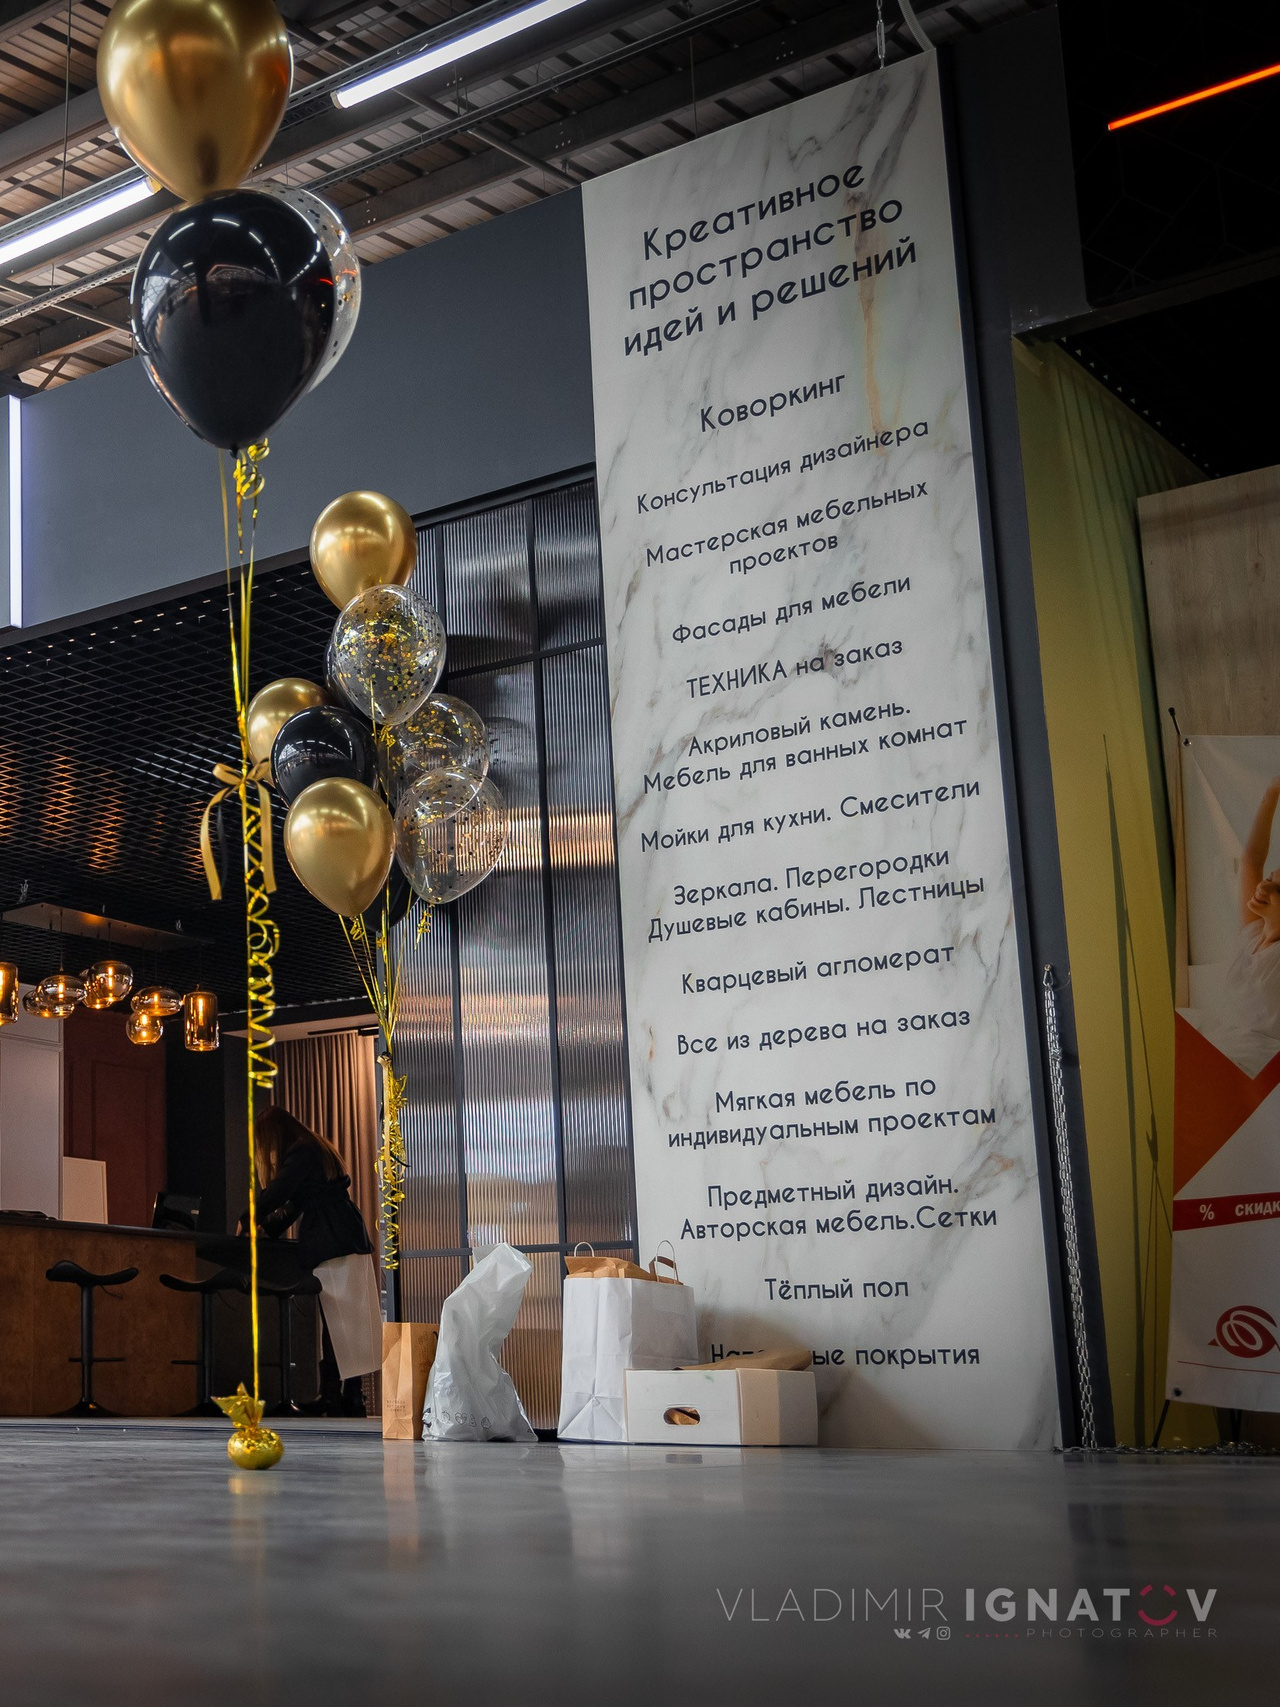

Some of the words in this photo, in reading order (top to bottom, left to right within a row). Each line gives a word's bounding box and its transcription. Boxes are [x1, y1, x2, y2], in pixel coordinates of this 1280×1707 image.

[644, 166, 864, 260] Креативное
[630, 200, 902, 310] пространство
[625, 306, 703, 356] идей
[718, 301, 735, 325] и
[752, 242, 916, 321] решений
[701, 375, 845, 432] Коворкинг
[638, 460, 790, 514] Консультация
[800, 422, 928, 473] дизайнера
[647, 519, 787, 567] Мастерская
[797, 482, 927, 528] мебельных
[730, 536, 838, 575] проектов
[673, 611, 766, 643] Фасады
[776, 600, 812, 625] для
[822, 577, 910, 610] мебели
[686, 660, 787, 698] ТЕХНИКА
[795, 656, 825, 676] на
[834, 640, 903, 667] заказ
[643, 767, 731, 794] Мебель
[740, 757, 776, 780] для
[786, 739, 869, 767] ванных
[879, 720, 967, 750] комнат
[689, 716, 810, 756] Акриловый
[820, 703, 910, 730] камень.
[642, 828, 709, 852] Мойки
[718, 821, 754, 843] для
[764, 808, 831, 833] кухни.
[840, 781, 979, 817] Смесители
[674, 878, 778, 906] Зеркала.
[786, 851, 949, 888] Перегородки
[648, 912, 747, 943] Душевые
[757, 898, 849, 923] кабины.
[859, 878, 984, 909] Лестницы
[682, 961, 806, 994] Кварцевый
[817, 946, 954, 977] агломерат
[678, 1035, 718, 1055] Все
[727, 1035, 750, 1050] из
[759, 1024, 846, 1051] дерева
[857, 1019, 887, 1036] на
[898, 1011, 970, 1032] заказ
[716, 1091, 795, 1113] Мягкая
[805, 1081, 895, 1105] мебель
[906, 1079, 936, 1096] по
[669, 1119, 858, 1150] индивидуальным
[869, 1108, 995, 1136] проектам
[708, 1180, 855, 1210] Предметный
[866, 1174, 958, 1202] дизайн.
[681, 1219, 806, 1241] Авторская
[816, 1206, 997, 1233] мебель.Сетки
[764, 1278, 853, 1300] Тёплый
[863, 1281, 908, 1297] пол
[856, 1348, 979, 1369] покрытия
